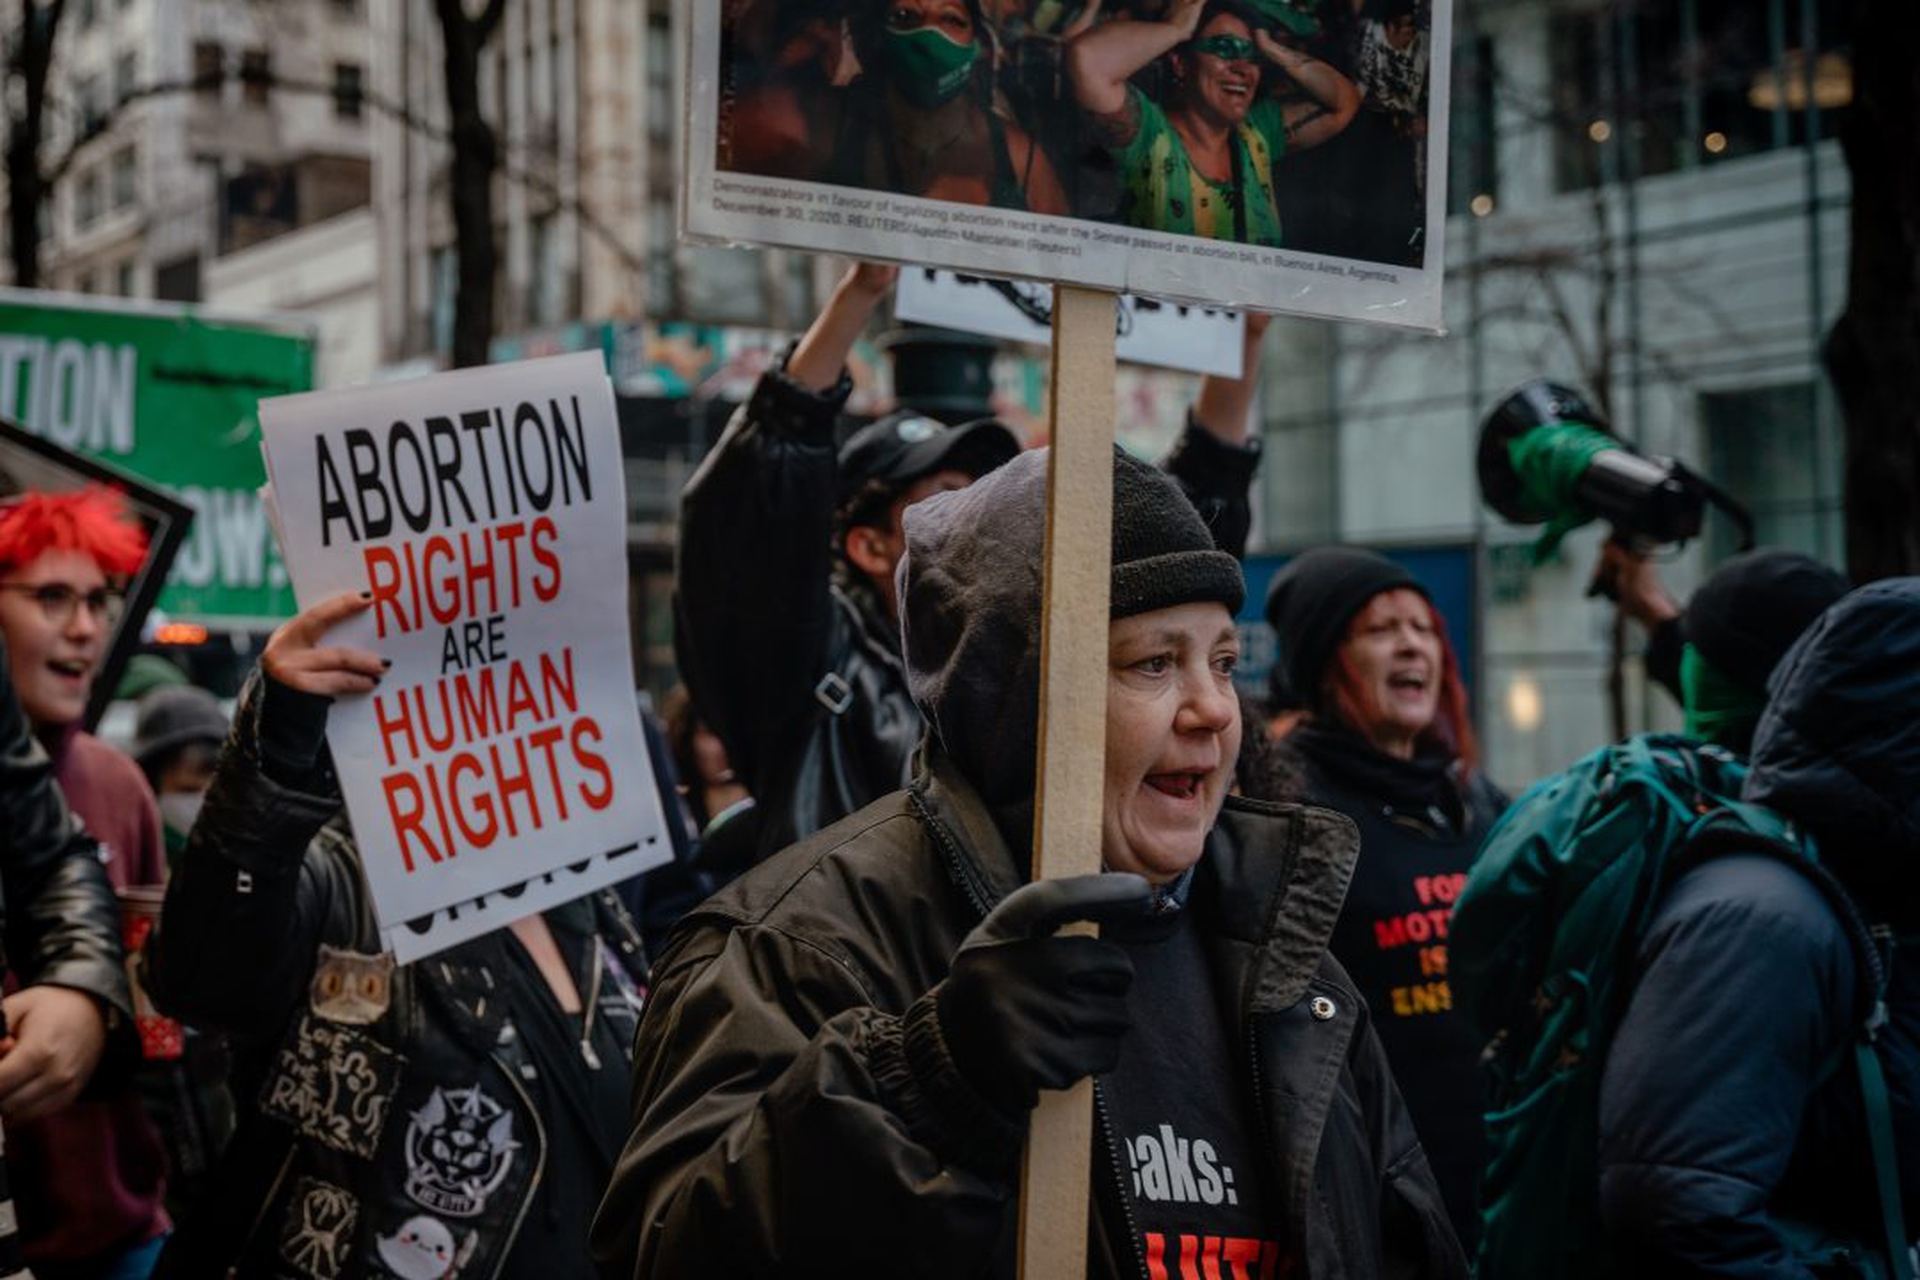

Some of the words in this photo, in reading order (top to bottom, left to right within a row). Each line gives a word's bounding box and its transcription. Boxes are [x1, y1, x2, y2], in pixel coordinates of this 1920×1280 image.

[712, 178, 814, 201] Demonstrators
[817, 193, 830, 203] in
[832, 194, 871, 208] favour
[876, 198, 889, 210] of
[891, 205, 949, 222] legalizing
[952, 208, 1005, 226] abortion
[1007, 220, 1038, 232] react
[1040, 222, 1070, 235] after
[1071, 226, 1090, 239] the
[1092, 228, 1130, 244] Senate
[1132, 236, 1173, 252] passed
[1175, 244, 1189, 254] an
[1192, 245, 1239, 261] abortion
[1274, 255, 1315, 272] Buenos
[712, 197, 782, 217] December
[1026, 236, 1082, 257] (Reuters)
[316, 395, 592, 546] ABORTION
[160, 484, 287, 588] OW!
[364, 516, 561, 639] RIGHTS
[440, 615, 507, 675] ARE
[374, 647, 578, 766] HUMAN
[381, 716, 613, 873] RIGHTS
[1374, 909, 1456, 948] MOT
[1125, 1124, 1238, 1204] aks:
